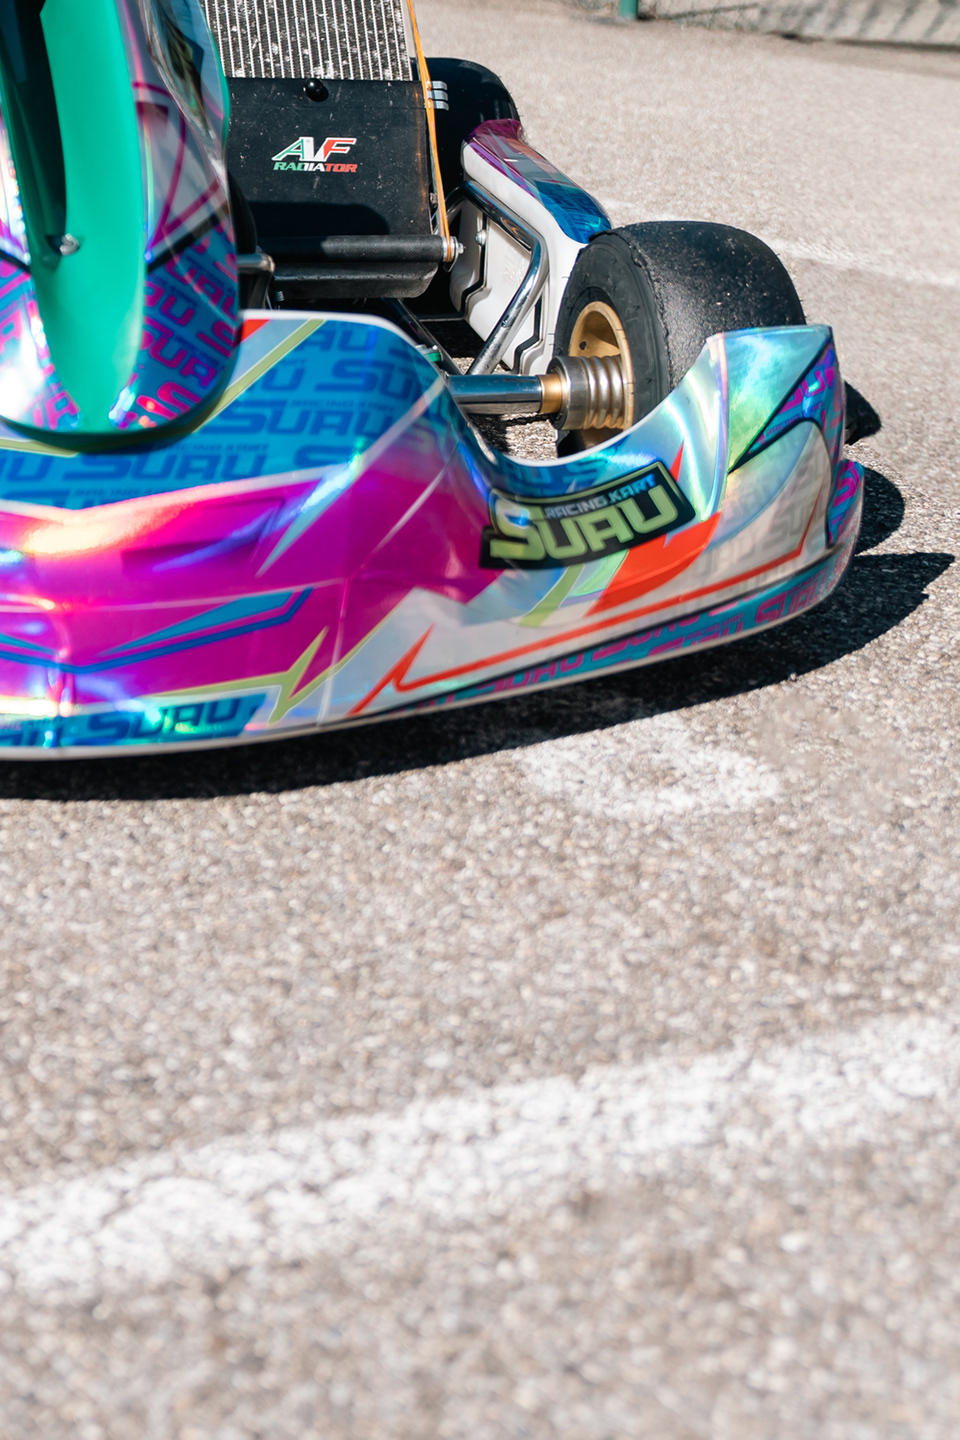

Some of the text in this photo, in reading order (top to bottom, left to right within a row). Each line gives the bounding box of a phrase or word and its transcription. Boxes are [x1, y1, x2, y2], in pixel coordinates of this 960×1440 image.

[271, 136, 357, 162] AF
[273, 162, 358, 173] RADIATOR
[490, 484, 678, 560] SUAU
